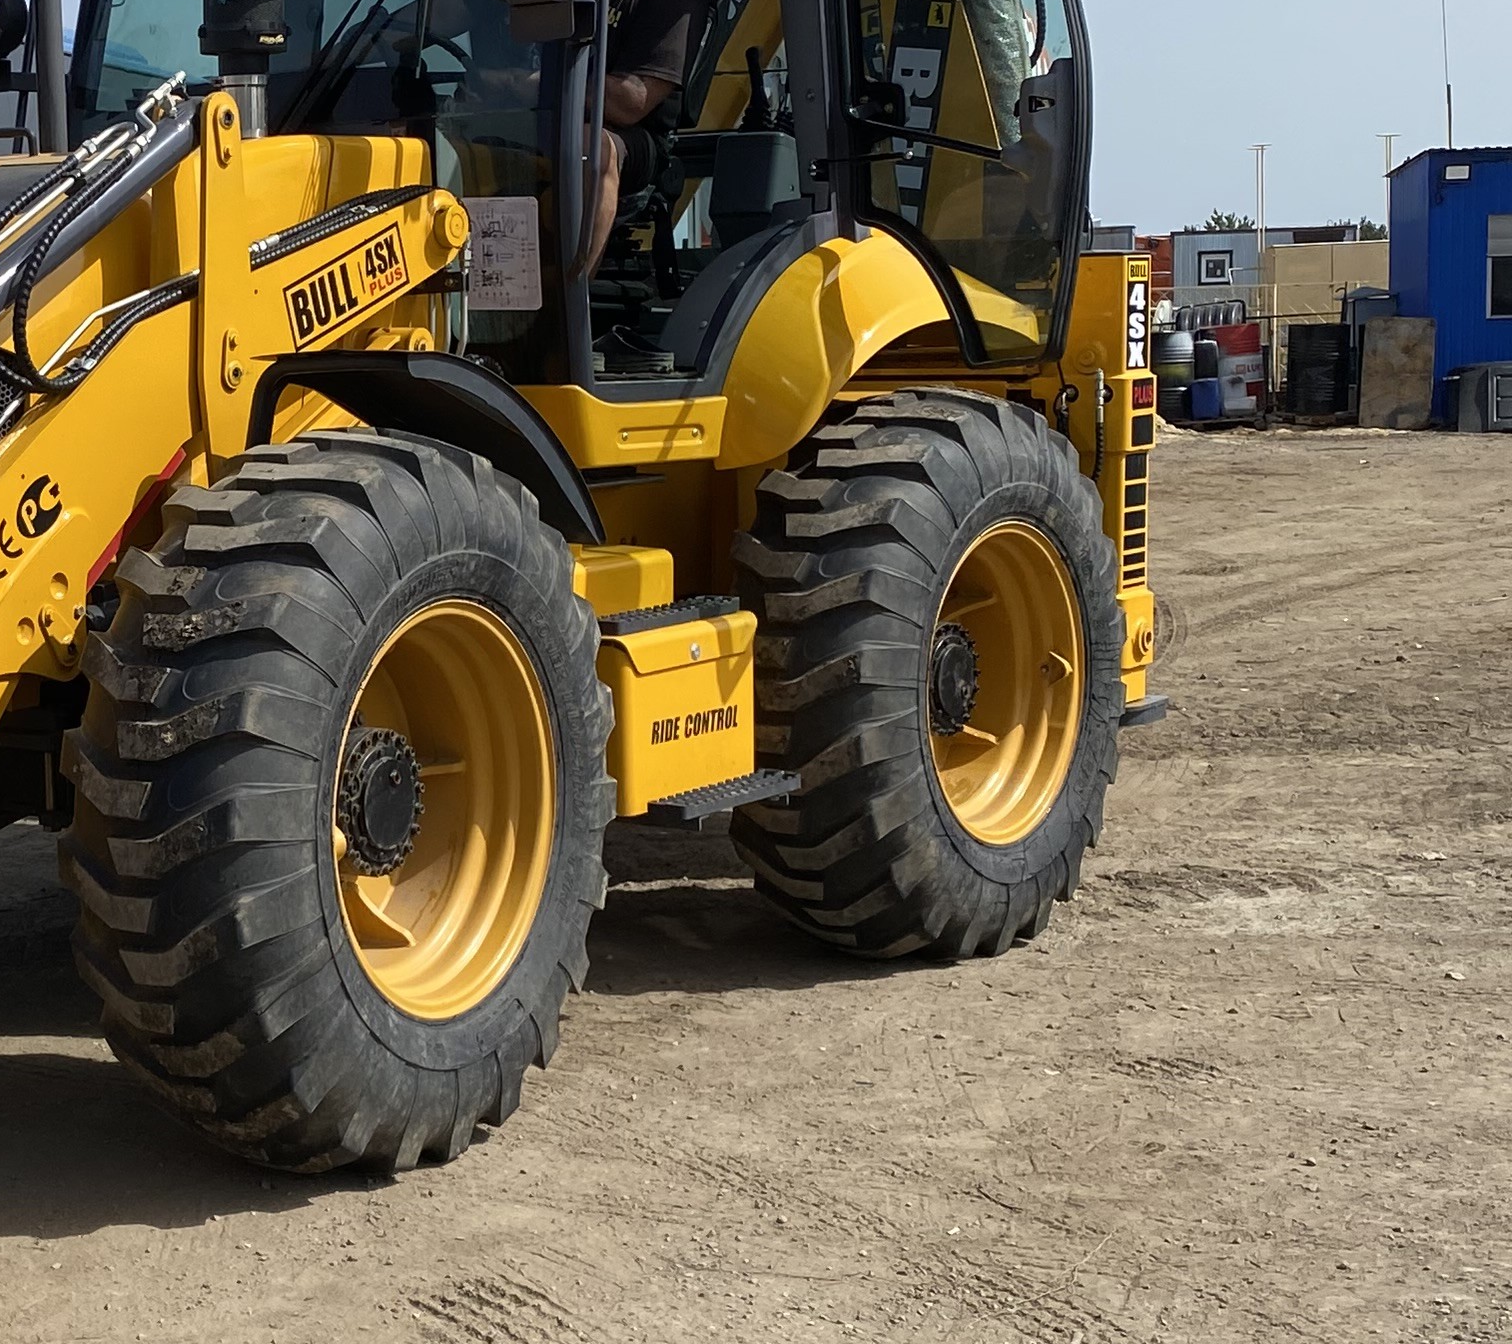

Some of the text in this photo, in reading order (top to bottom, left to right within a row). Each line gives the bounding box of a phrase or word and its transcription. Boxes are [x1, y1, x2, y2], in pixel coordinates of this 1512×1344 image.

[290, 262, 359, 340] BULL
[364, 235, 401, 280] 4SX
[369, 267, 403, 296] PLUS
[1130, 264, 1147, 278] BULL
[1128, 283, 1146, 367] 4SX
[651, 704, 738, 745] RIDE CONTROL
